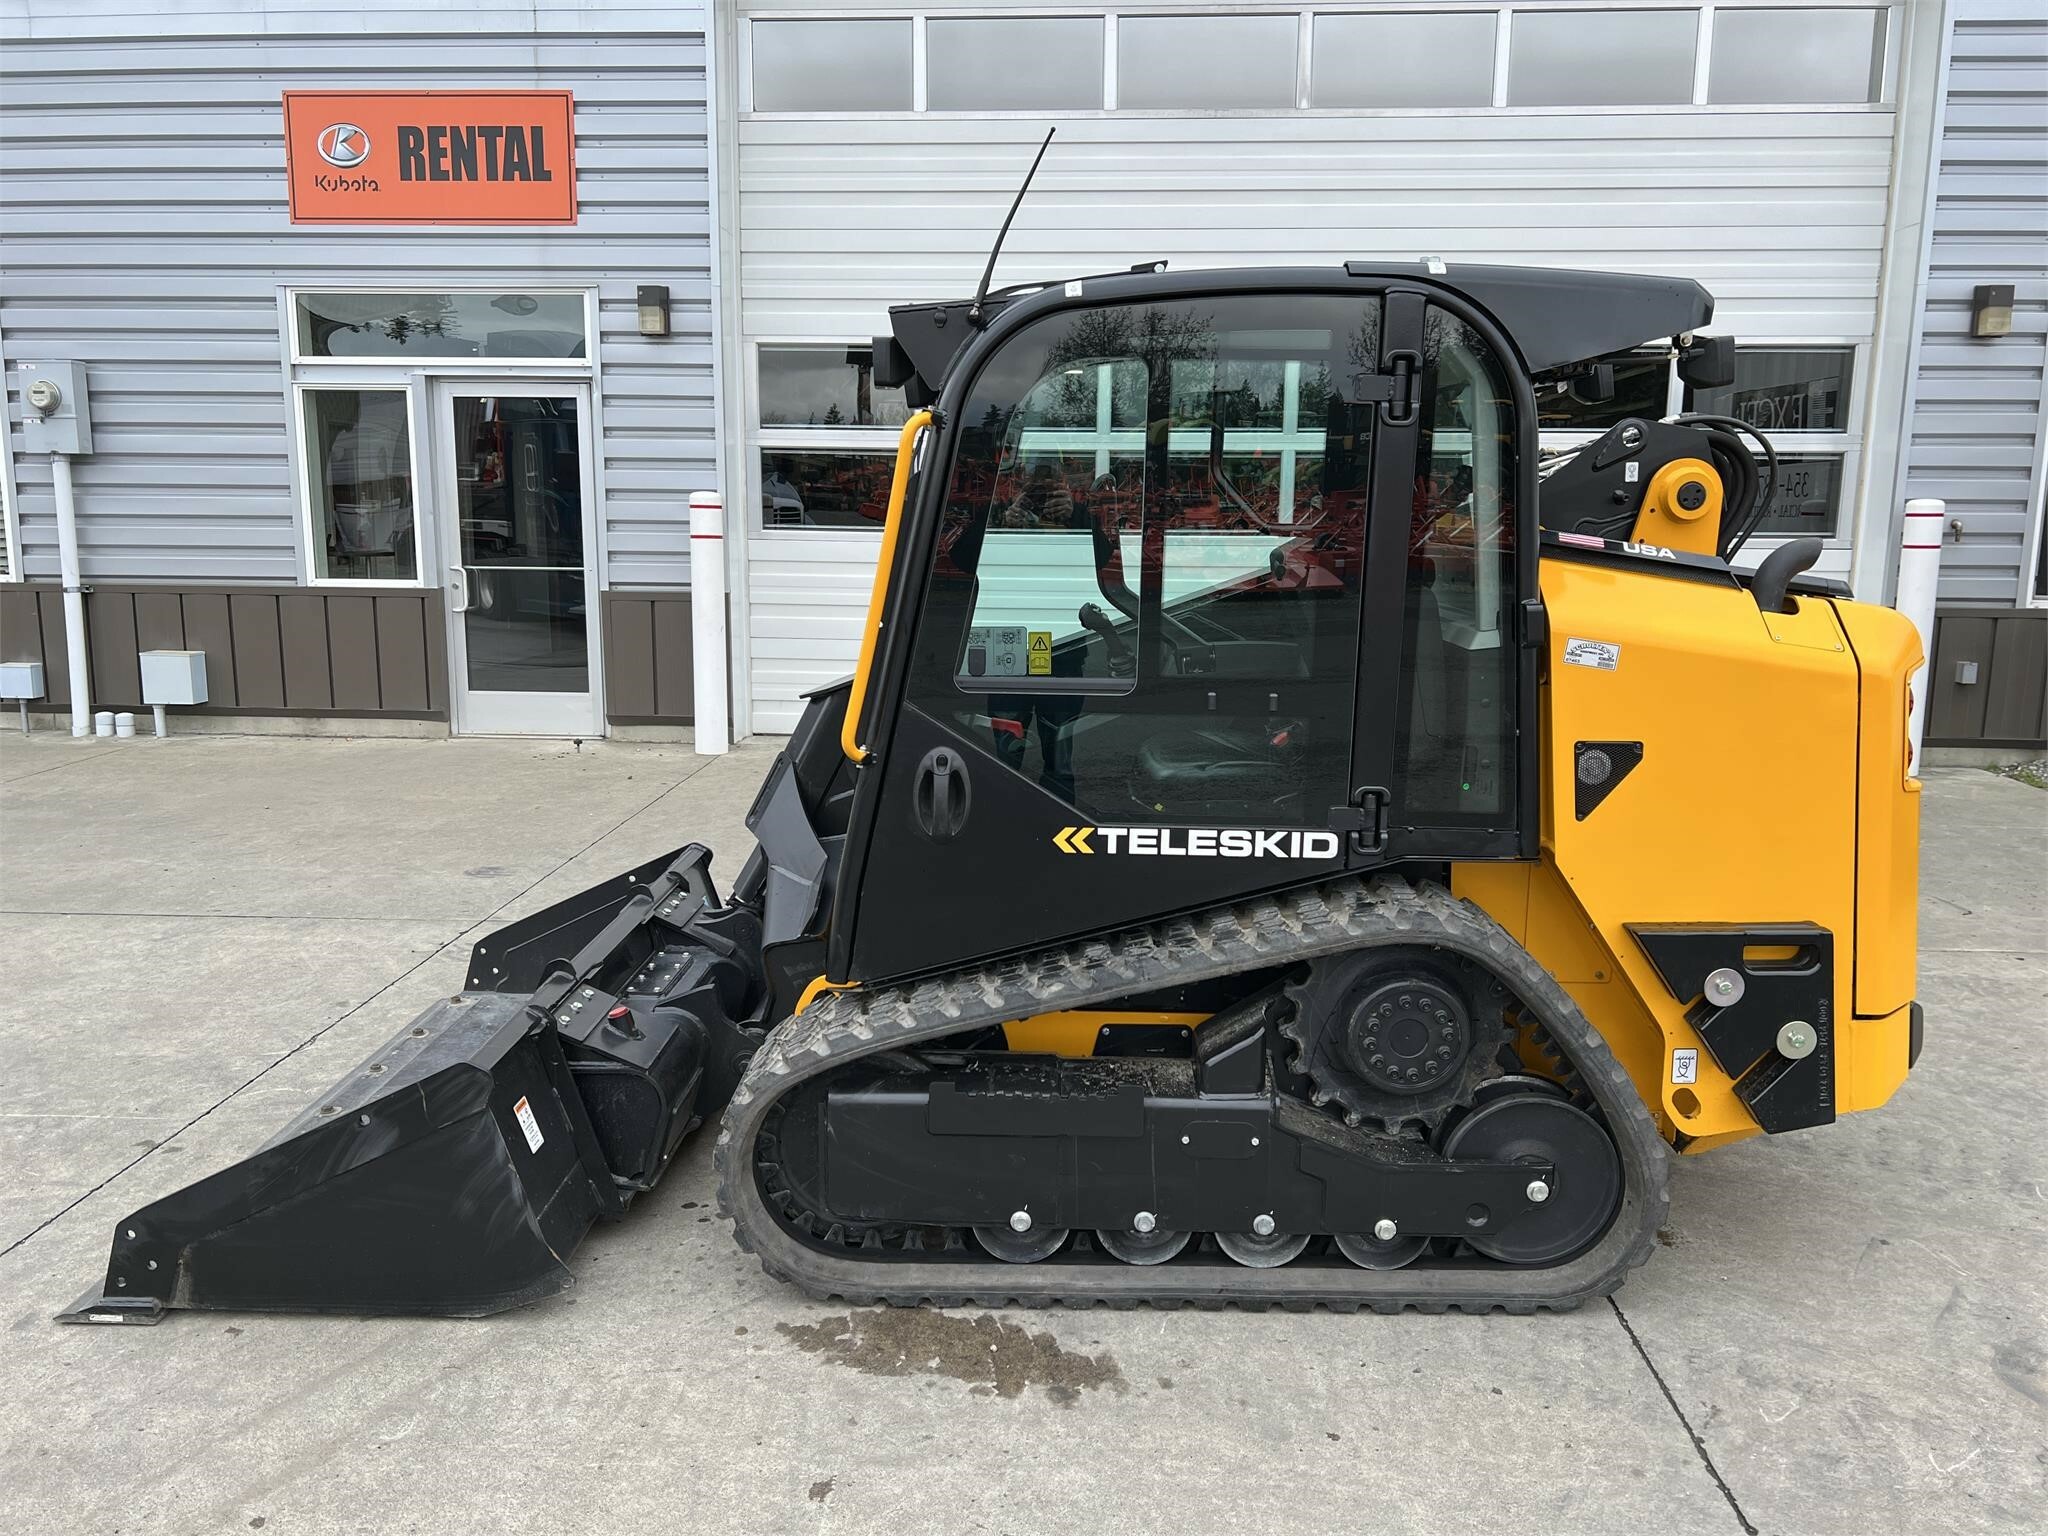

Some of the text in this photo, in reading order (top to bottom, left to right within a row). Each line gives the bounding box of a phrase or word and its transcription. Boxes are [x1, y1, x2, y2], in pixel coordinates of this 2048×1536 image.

[397, 126, 552, 181] RENTAL
[314, 175, 380, 192] Kubota
[1622, 541, 1676, 559] USA
[1097, 827, 1339, 859] TELESKID
